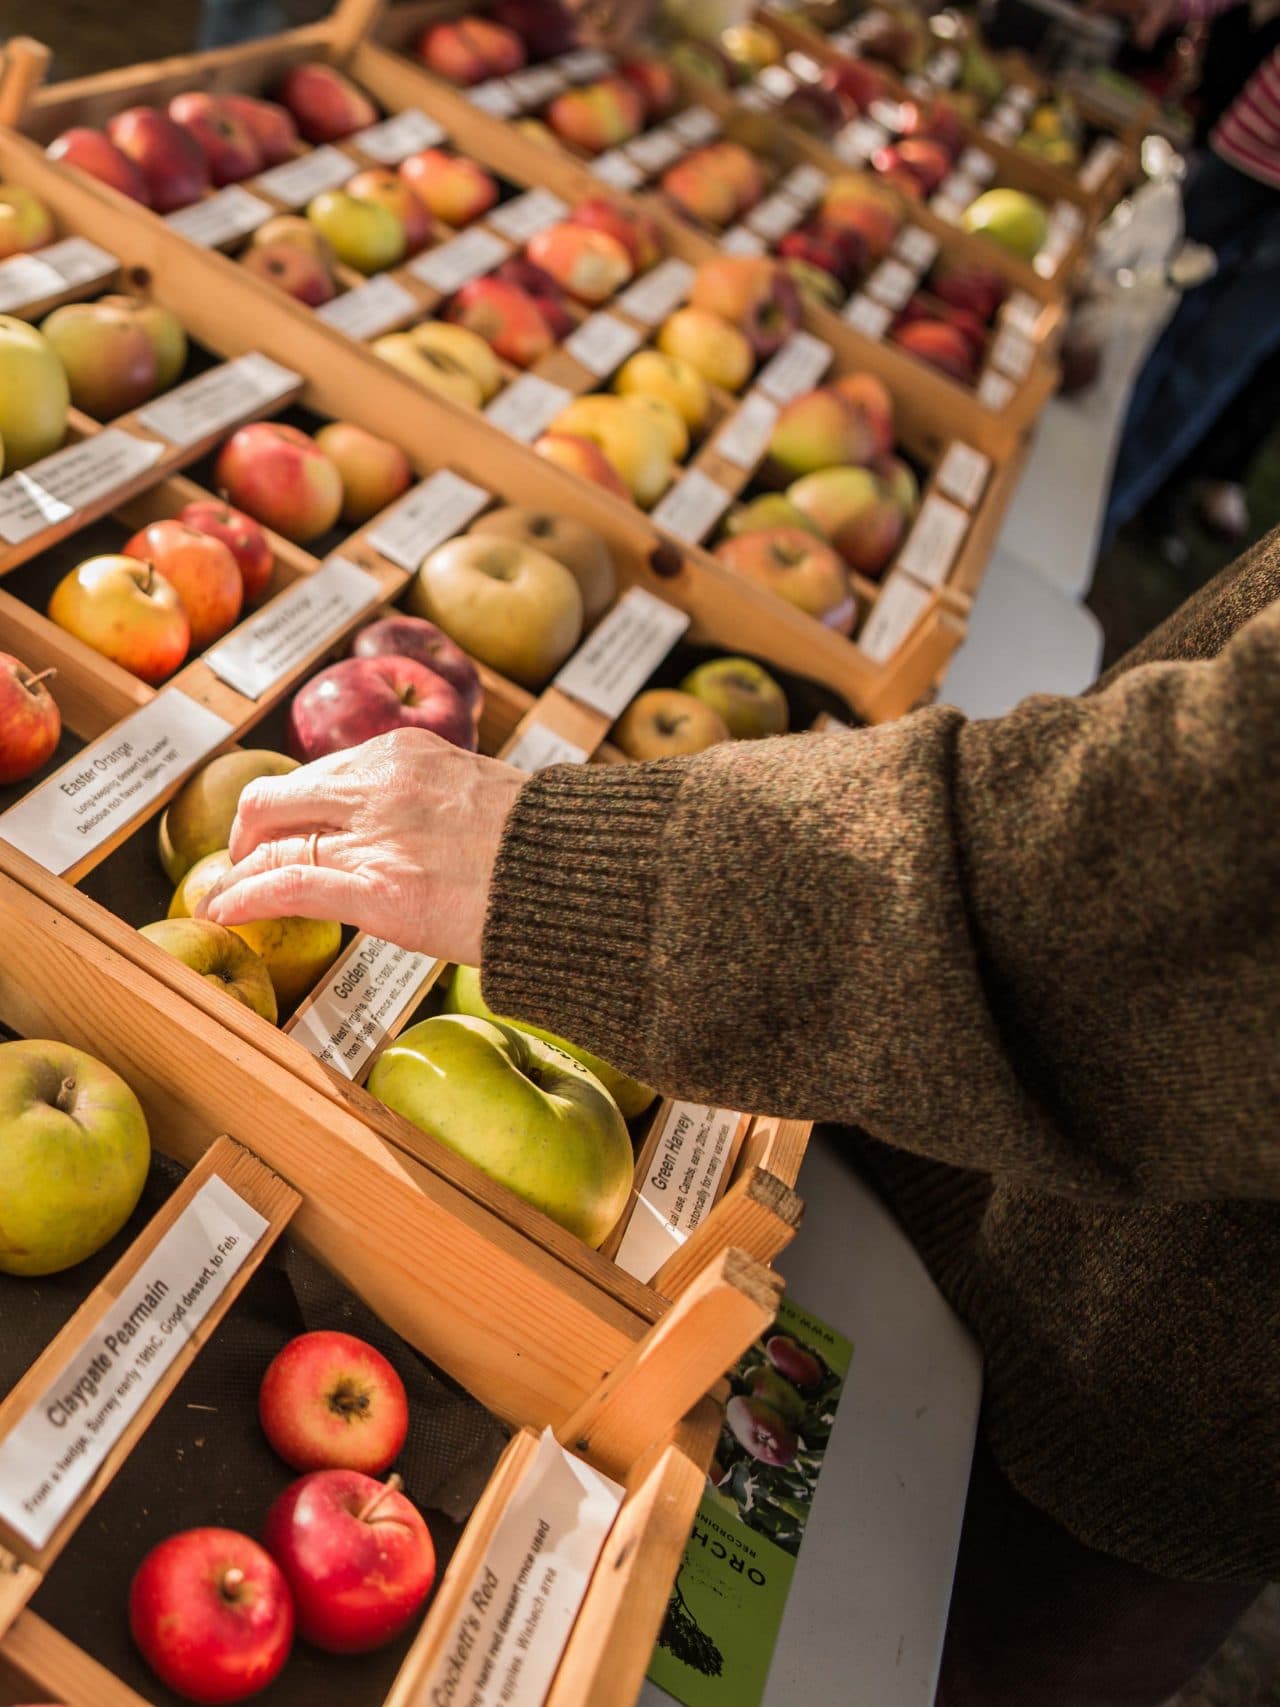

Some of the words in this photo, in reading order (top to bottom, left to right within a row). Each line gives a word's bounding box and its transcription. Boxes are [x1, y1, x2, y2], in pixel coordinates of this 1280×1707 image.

[59, 768, 97, 797] Easter
[92, 742, 134, 771] Orange
[76, 808, 111, 835] Delicious
[333, 962, 369, 1000] Golden
[359, 935, 388, 965] Delic
[319, 1044, 335, 1062] rigin
[330, 1025, 350, 1046] West
[342, 1042, 362, 1061] from
[369, 998, 393, 1024] France
[650, 1153, 677, 1191] Green
[664, 1112, 695, 1155] Harvey
[699, 1174, 713, 1190] for
[706, 1154, 722, 1177] many
[664, 1210, 680, 1232] Dual
[674, 1196, 687, 1213] use,
[690, 1146, 705, 1166] early
[209, 1254, 224, 1268] to
[216, 1235, 238, 1257] Feb.
[182, 1267, 217, 1307] dessert,
[159, 1303, 187, 1334] Good
[46, 1353, 112, 1429] Claygate
[103, 1279, 169, 1357] Pearmain
[116, 1368, 142, 1397] early
[85, 1395, 120, 1434] Surrey
[23, 1482, 52, 1513] From
[690, 1526, 767, 1587] ORCH
[471, 1566, 499, 1615] Red
[474, 1656, 494, 1689] hard
[487, 1631, 503, 1657] red
[497, 1583, 521, 1633] dessert
[516, 1553, 535, 1584] once
[530, 1518, 551, 1553] used
[515, 1596, 545, 1651] Wisbech
[540, 1567, 557, 1596] area
